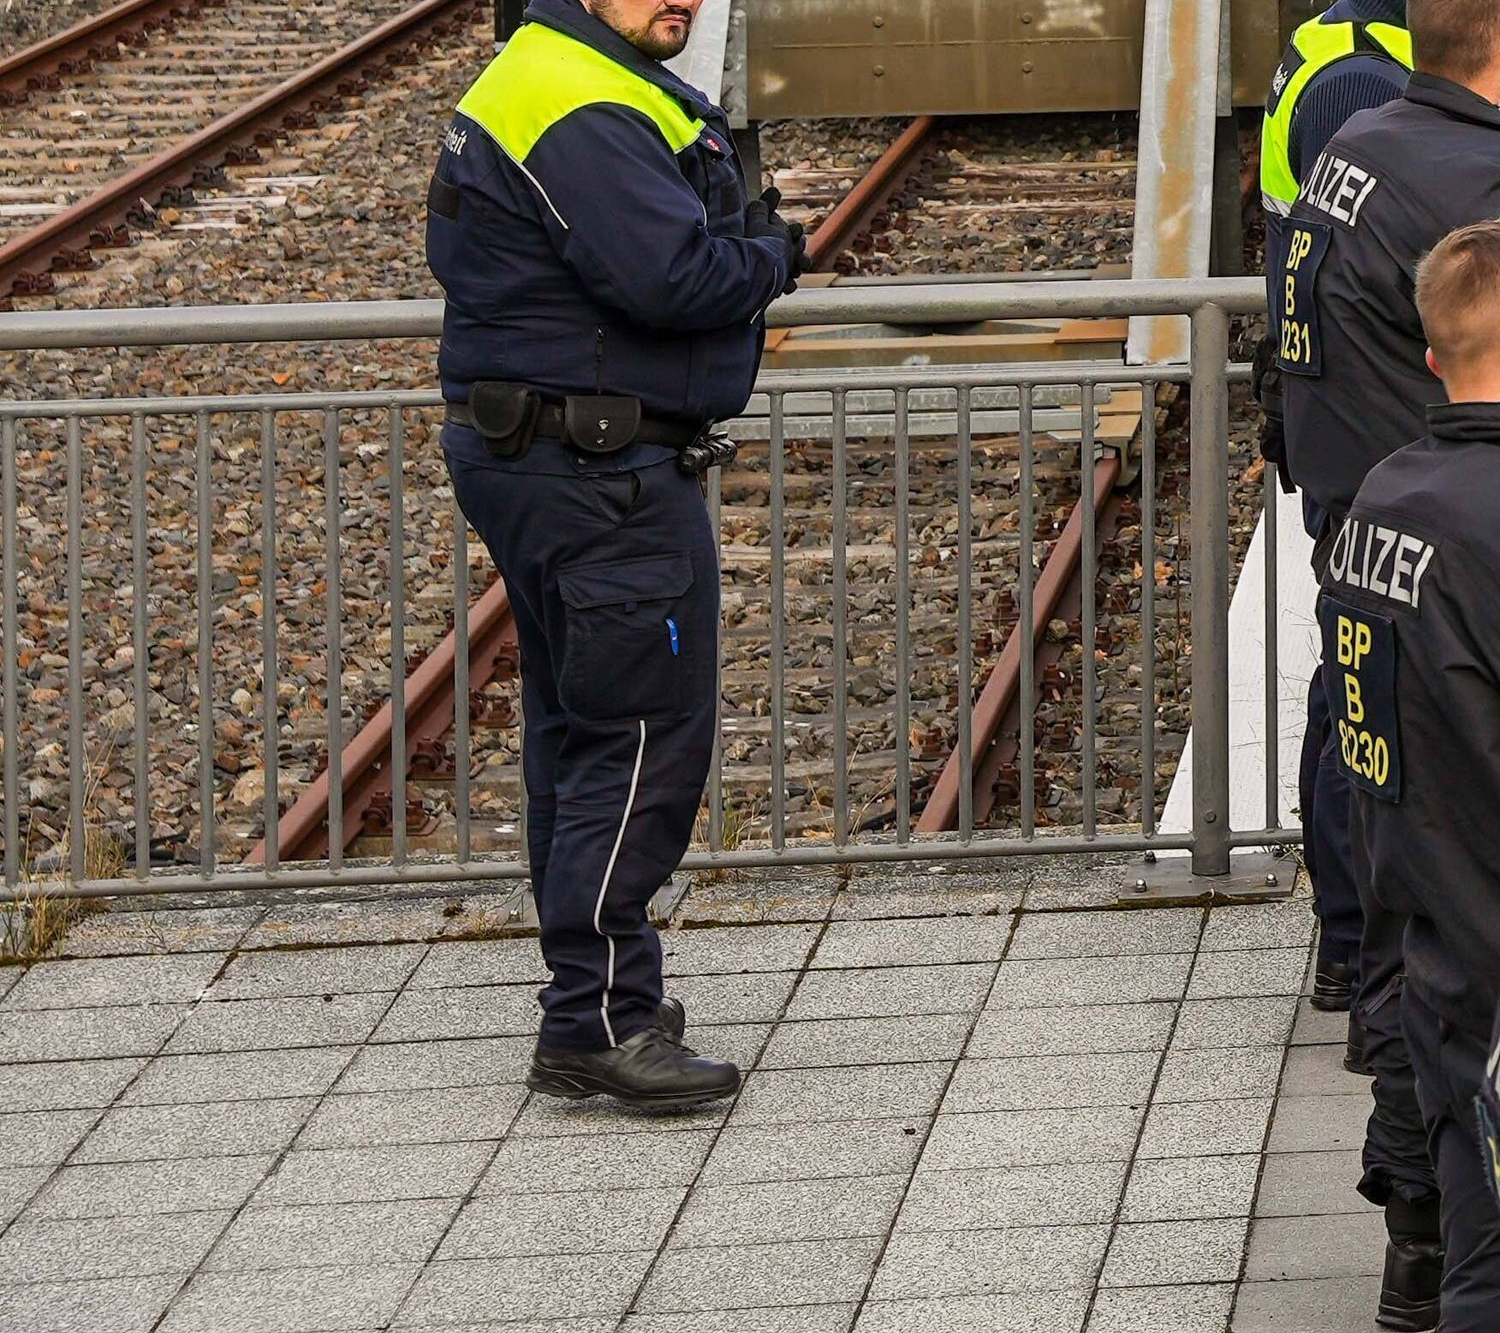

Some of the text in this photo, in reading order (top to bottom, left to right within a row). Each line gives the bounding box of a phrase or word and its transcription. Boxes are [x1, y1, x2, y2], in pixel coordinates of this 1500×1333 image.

[1291, 230, 1312, 270] BP
[1285, 275, 1296, 316] B
[1329, 517, 1434, 609] OLIZEI
[1338, 615, 1372, 669] BP
[1346, 673, 1365, 722] B
[1339, 719, 1390, 786] 8230
